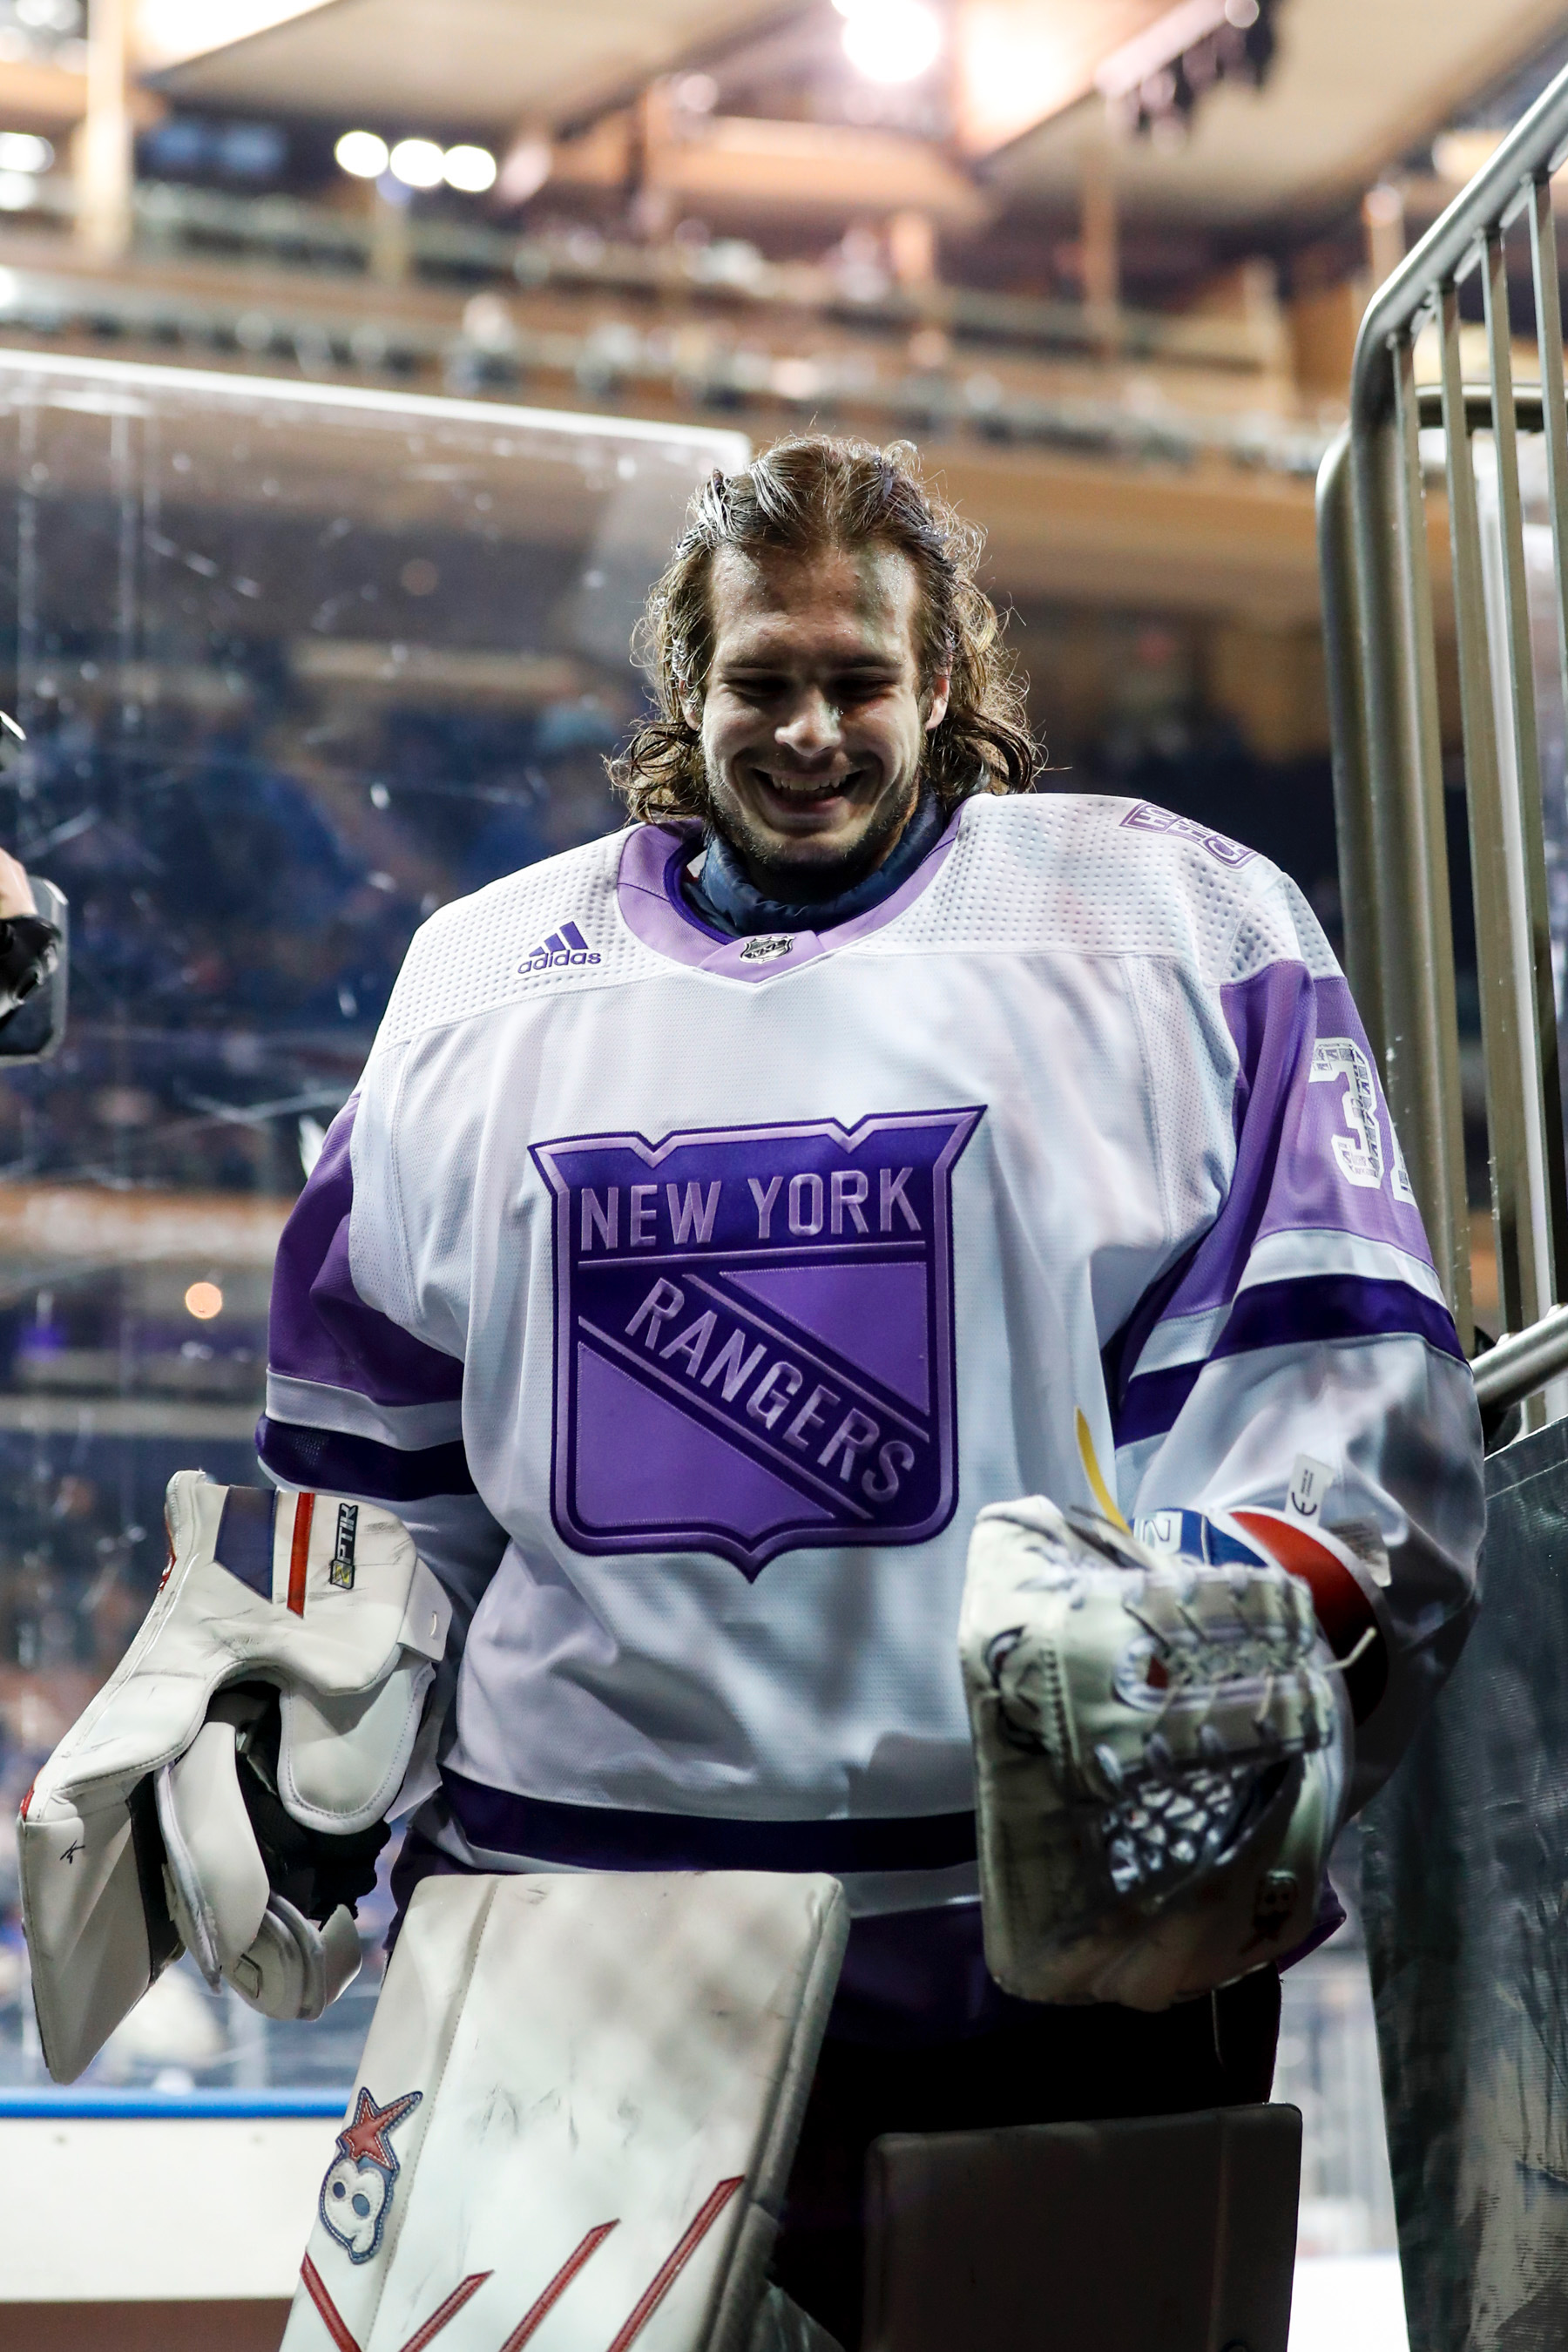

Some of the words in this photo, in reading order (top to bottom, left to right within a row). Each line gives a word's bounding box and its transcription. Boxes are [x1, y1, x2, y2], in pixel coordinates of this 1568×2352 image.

[517, 949, 602, 974] adidas
[1309, 1037, 1418, 1207] 3
[581, 1180, 721, 1252] NEW
[748, 1166, 921, 1240] YORK
[625, 1277, 915, 1503] RANGERS
